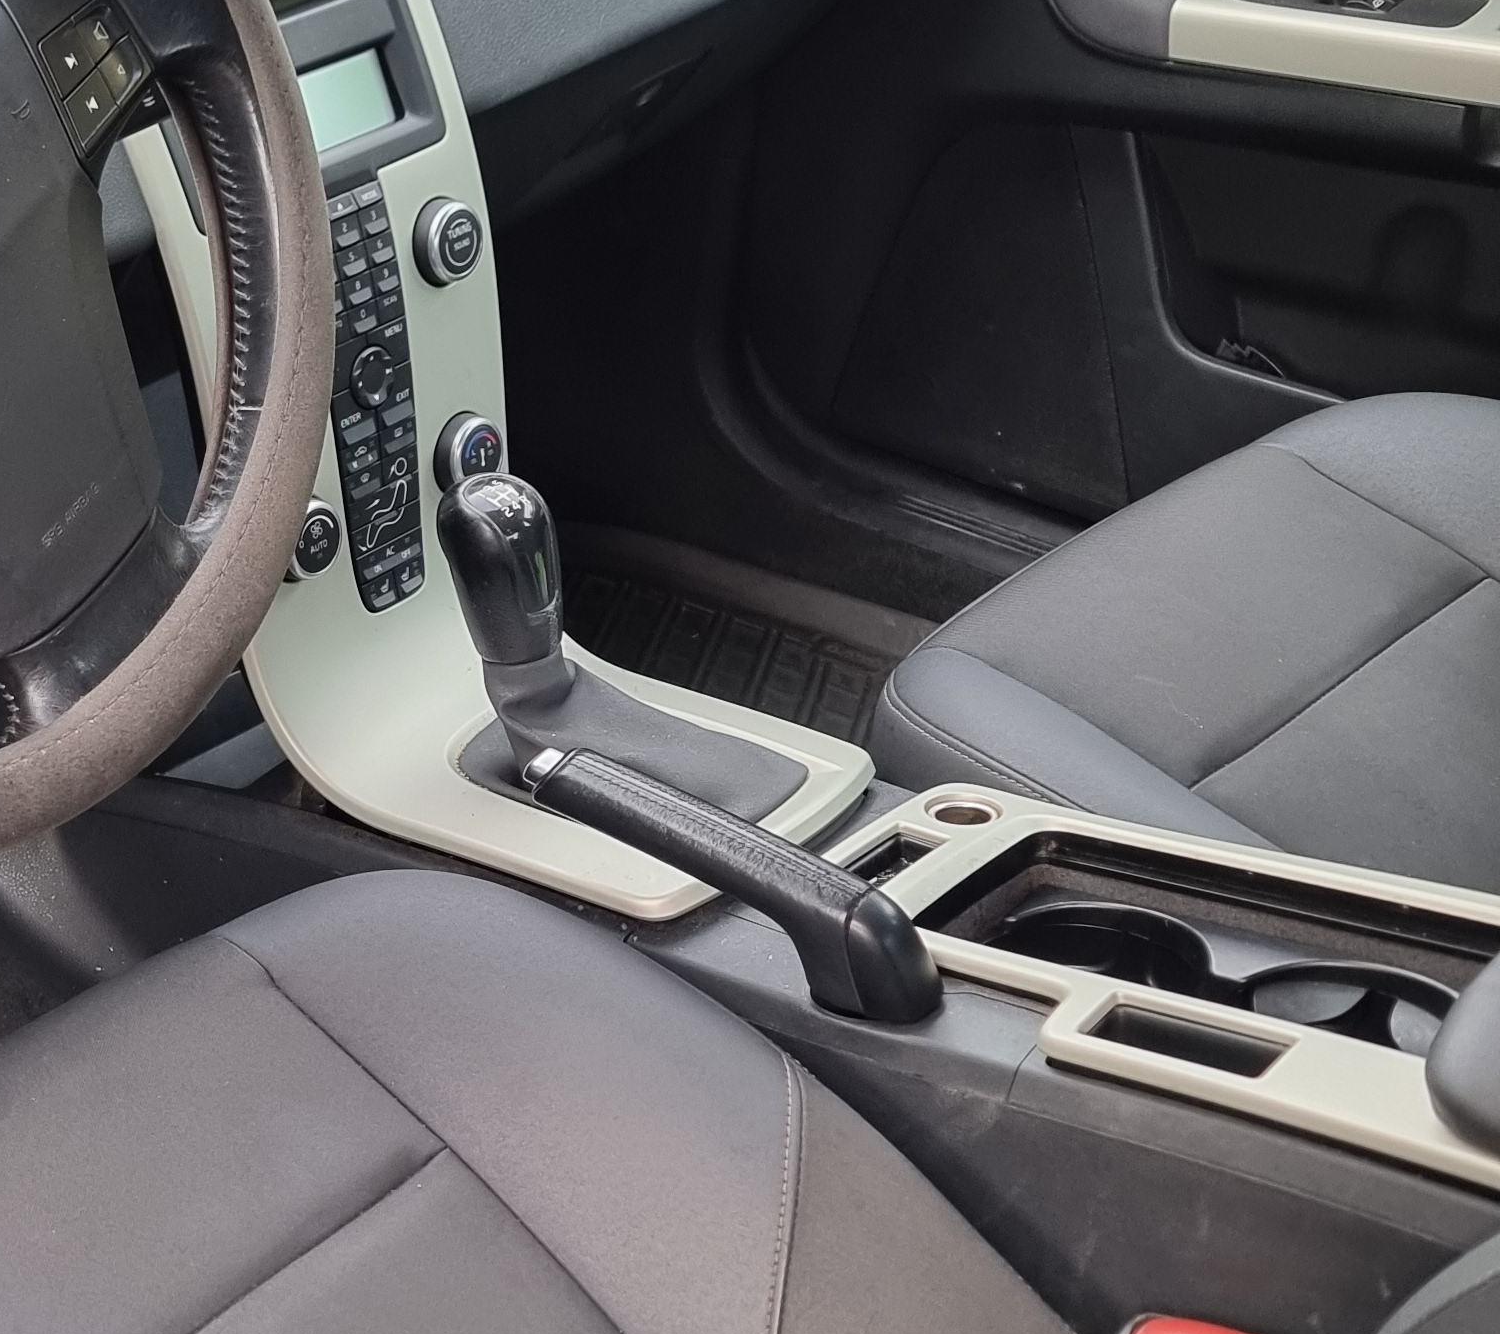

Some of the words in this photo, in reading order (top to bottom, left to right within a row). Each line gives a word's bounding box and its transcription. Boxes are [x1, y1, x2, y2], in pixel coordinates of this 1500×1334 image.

[383, 295, 398, 307] SCAN
[384, 323, 403, 338] MENU
[396, 388, 410, 402] EXIT
[340, 412, 362, 429] ENTER
[501, 507, 514, 518] 2
[512, 500, 521, 510] 4
[310, 539, 328, 554] AUTO
[385, 546, 396, 557] AC
[401, 548, 412, 558] OFF
